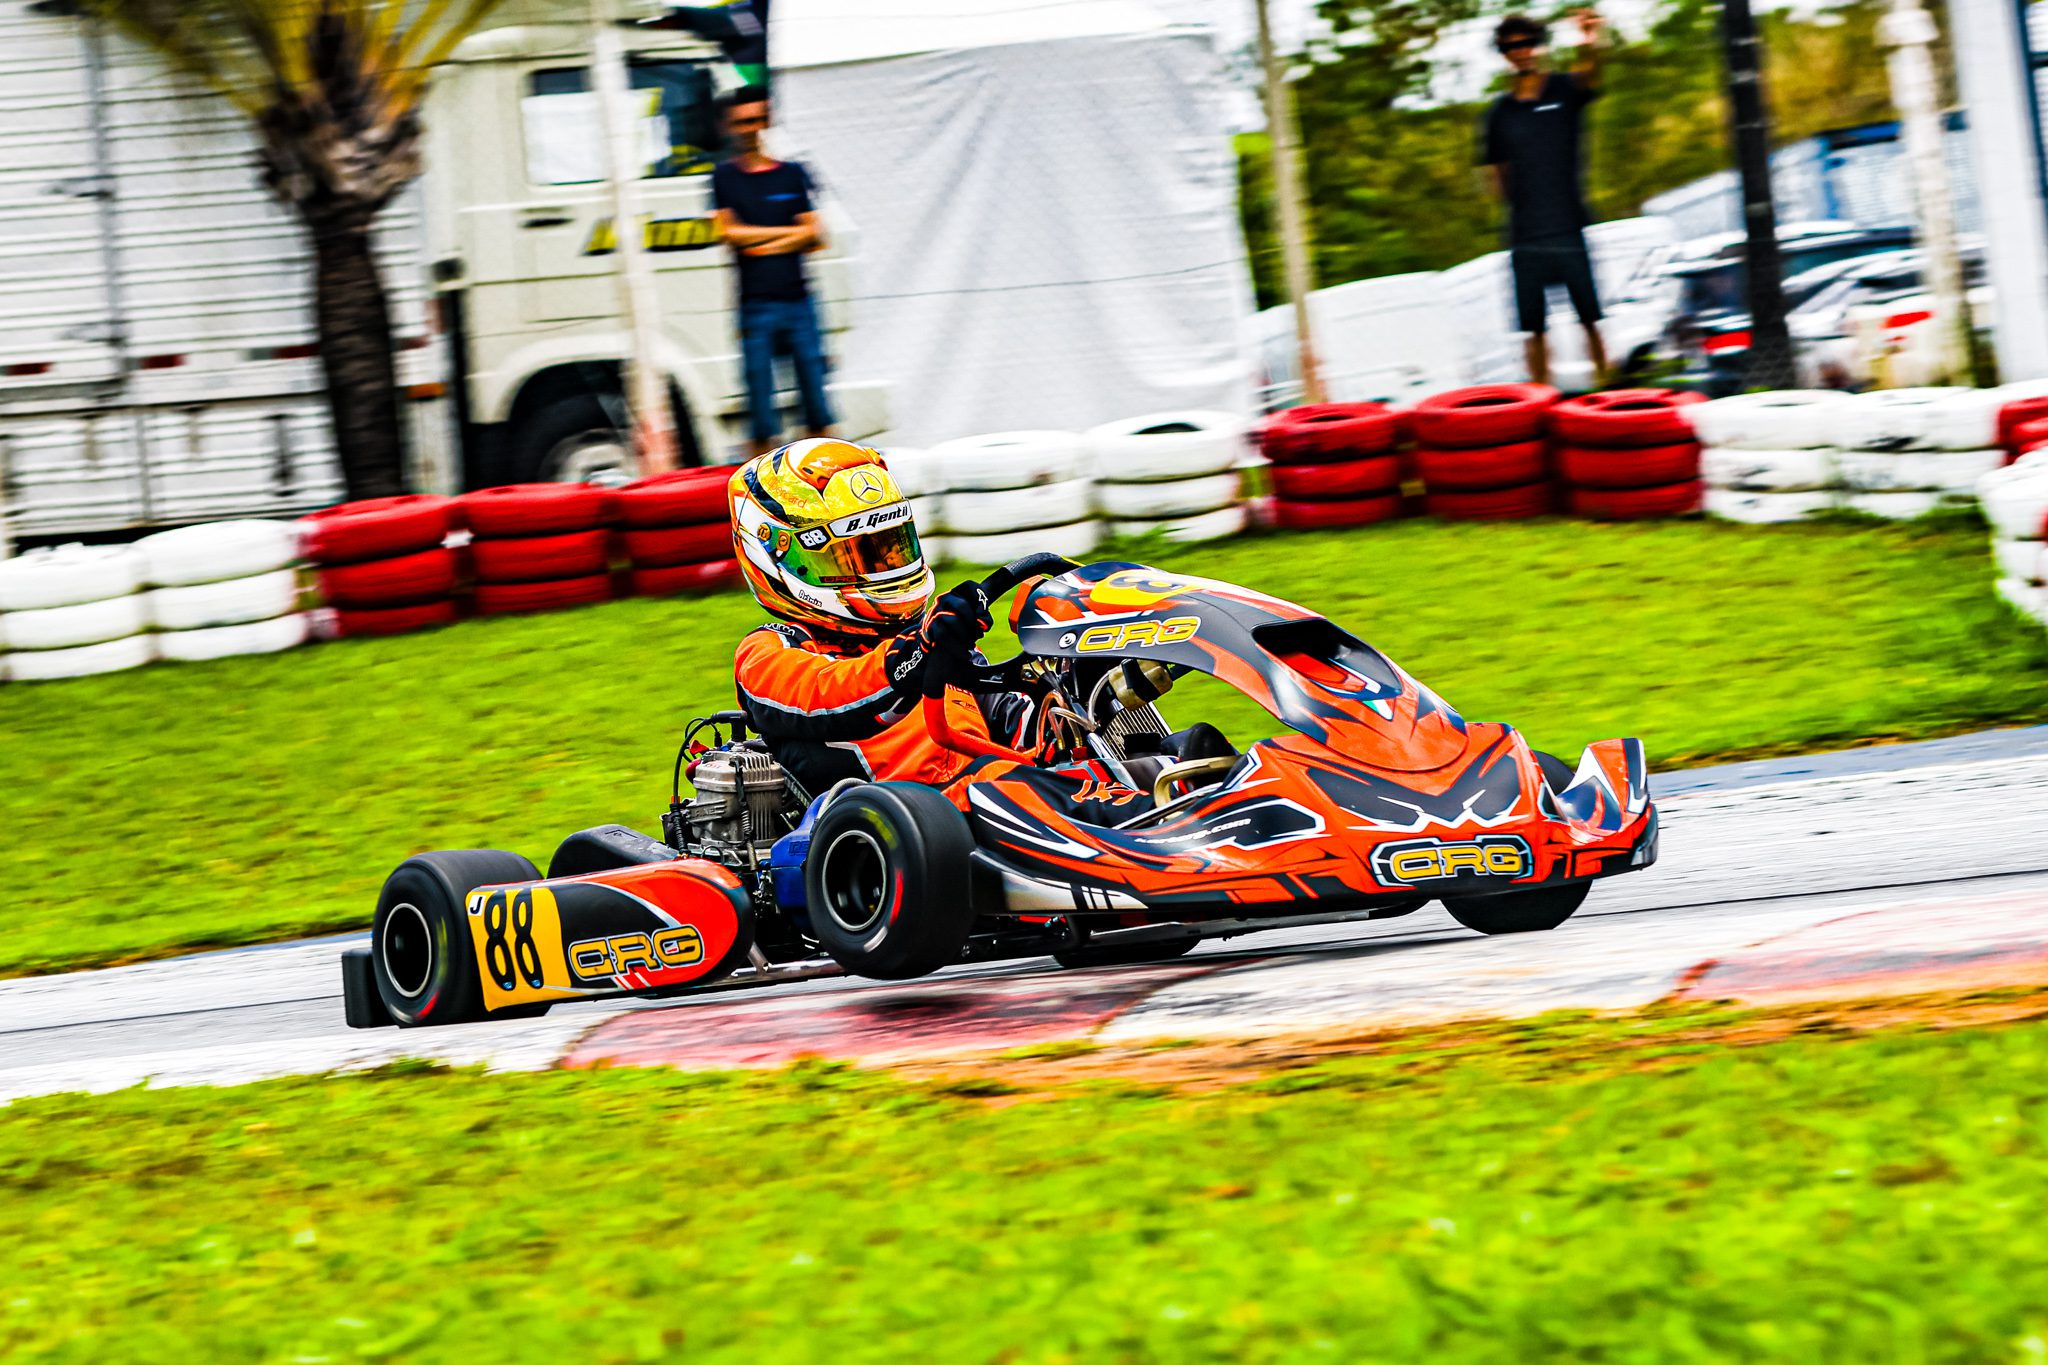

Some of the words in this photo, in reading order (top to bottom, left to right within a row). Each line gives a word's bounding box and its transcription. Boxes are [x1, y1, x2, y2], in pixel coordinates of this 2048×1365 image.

[866, 505, 908, 528] Gentil
[800, 529, 827, 547] 88
[757, 622, 796, 636] parco
[1077, 616, 1201, 653] CRG
[1390, 843, 1523, 883] CRG
[470, 896, 483, 915] J
[484, 888, 544, 991] 88
[568, 924, 705, 981] CRG
